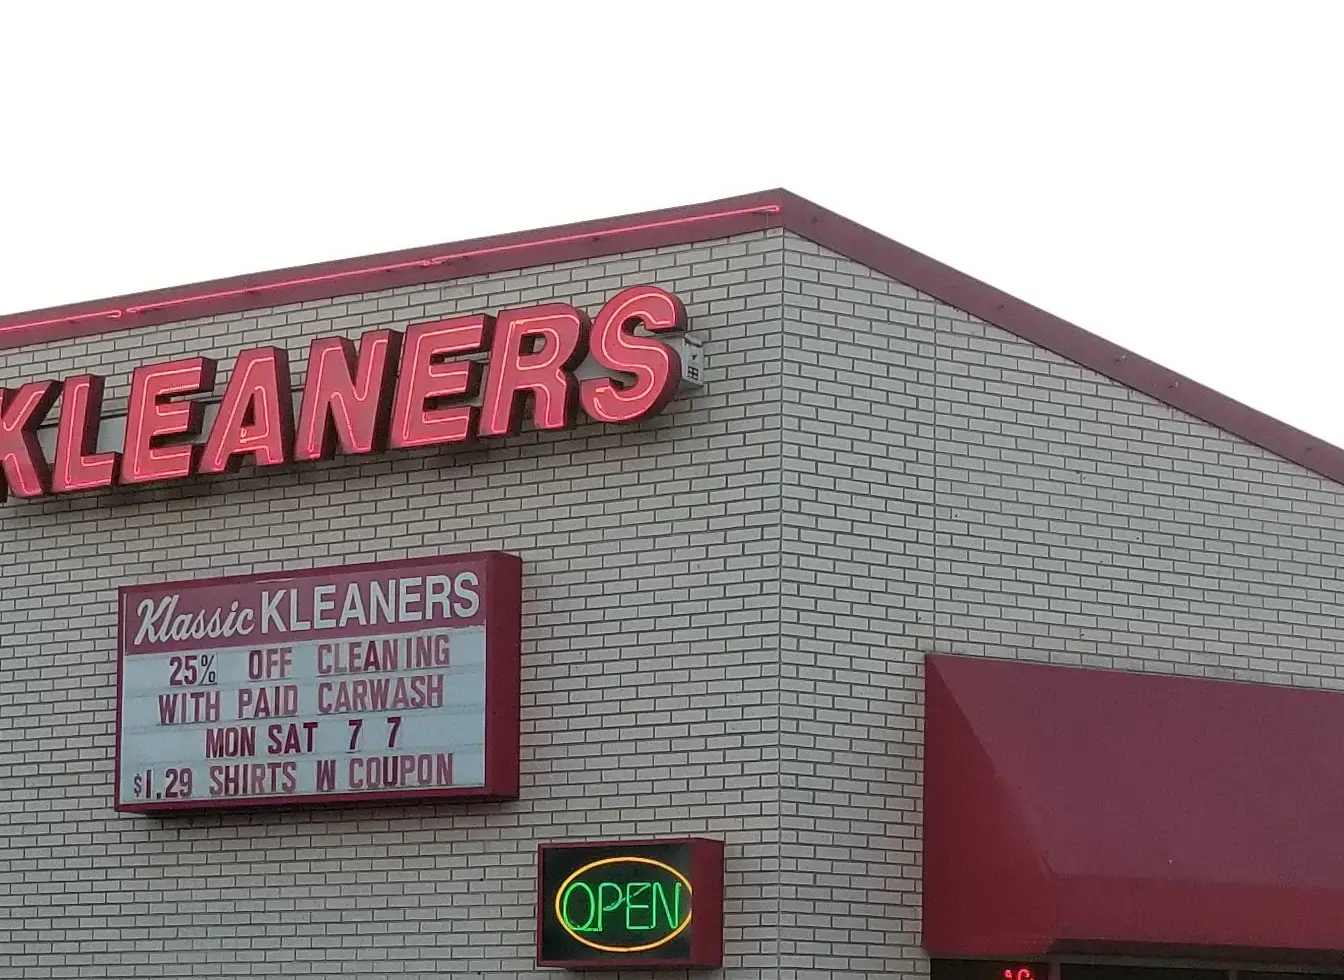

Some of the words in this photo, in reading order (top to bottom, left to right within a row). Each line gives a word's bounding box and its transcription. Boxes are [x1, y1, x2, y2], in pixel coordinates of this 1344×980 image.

[133, 594, 254, 646] Klassic
[261, 571, 479, 634] KLEANERS
[169, 654, 218, 686] 25%
[248, 647, 292, 680] OFF
[317, 634, 450, 675] CLEANING
[158, 691, 221, 725] WITH
[238, 684, 298, 718] PAID
[318, 675, 444, 714] CARWASH
[206, 726, 255, 759] MON
[267, 721, 318, 754] SAT
[348, 719, 363, 751] 7
[387, 717, 401, 748] 7
[133, 768, 193, 799] $1.29
[209, 761, 297, 796] SHIRTS
[316, 759, 336, 791] W
[349, 753, 453, 788] COUPON
[563, 882, 682, 932] OPEN
